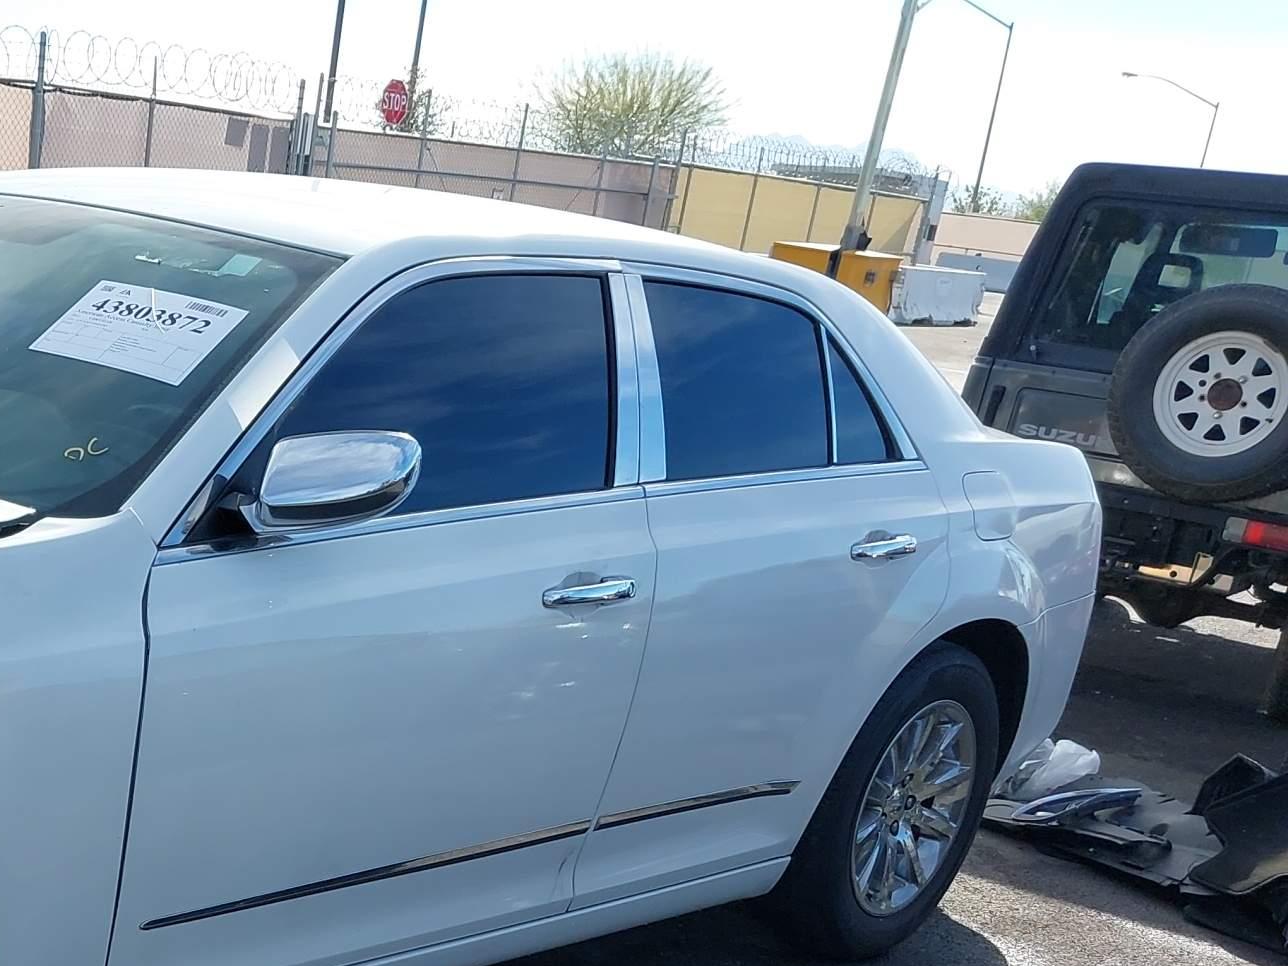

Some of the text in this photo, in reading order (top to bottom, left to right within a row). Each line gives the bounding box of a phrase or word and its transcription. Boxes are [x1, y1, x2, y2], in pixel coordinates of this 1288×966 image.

[383, 92, 407, 111] STOP
[92, 299, 211, 334] 43803872
[1018, 423, 1096, 446] SUZU
